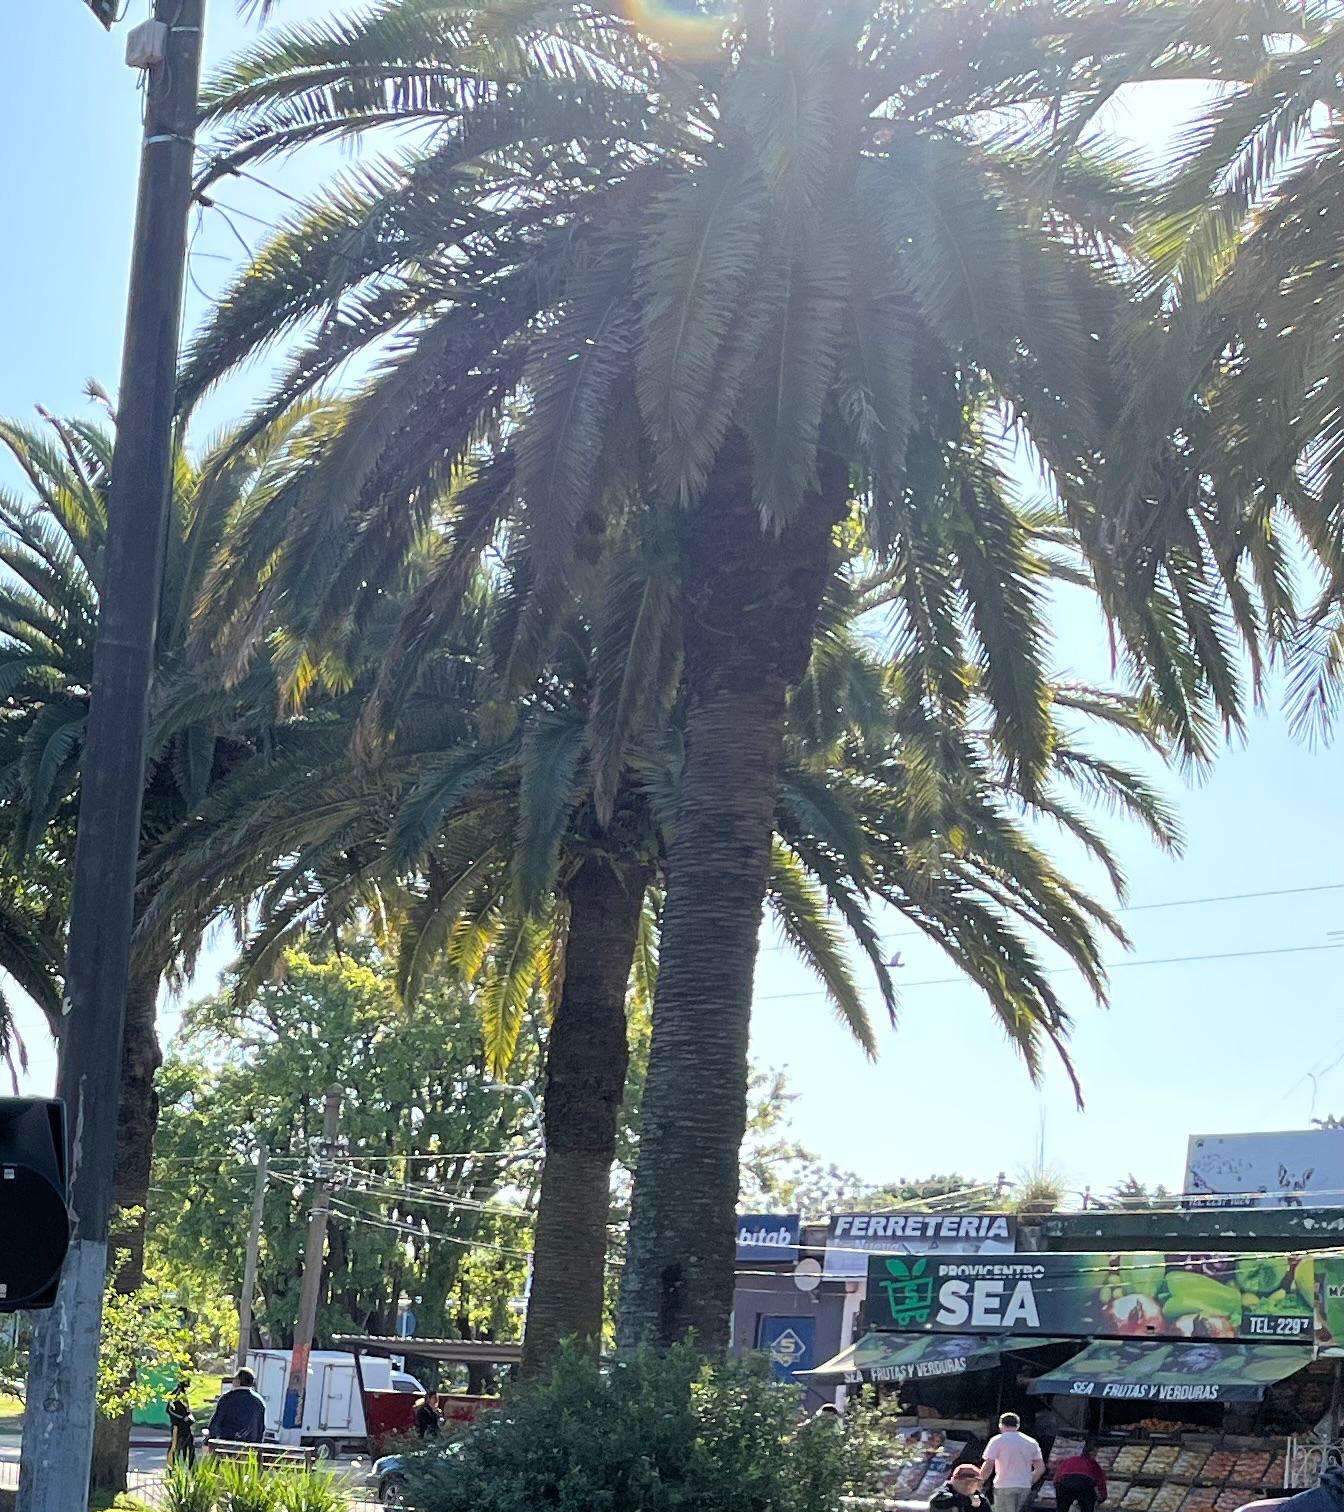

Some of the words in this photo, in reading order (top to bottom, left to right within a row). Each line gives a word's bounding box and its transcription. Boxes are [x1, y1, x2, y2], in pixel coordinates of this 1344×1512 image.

[834, 1216, 1010, 1238] FERRETERIA
[938, 1265, 1045, 1279] PROVICENTRO
[935, 1279, 1041, 1327] SEA
[843, 1369, 864, 1383] SEA
[871, 1365, 907, 1382] FRUTAS
[907, 1363, 915, 1378] Y
[915, 1357, 968, 1378] VERDURAS
[1070, 1381, 1095, 1395] SEA
[1102, 1383, 1149, 1398] FRUTAS
[1148, 1384, 1159, 1398] Y
[1160, 1384, 1220, 1400] VERDURAS
